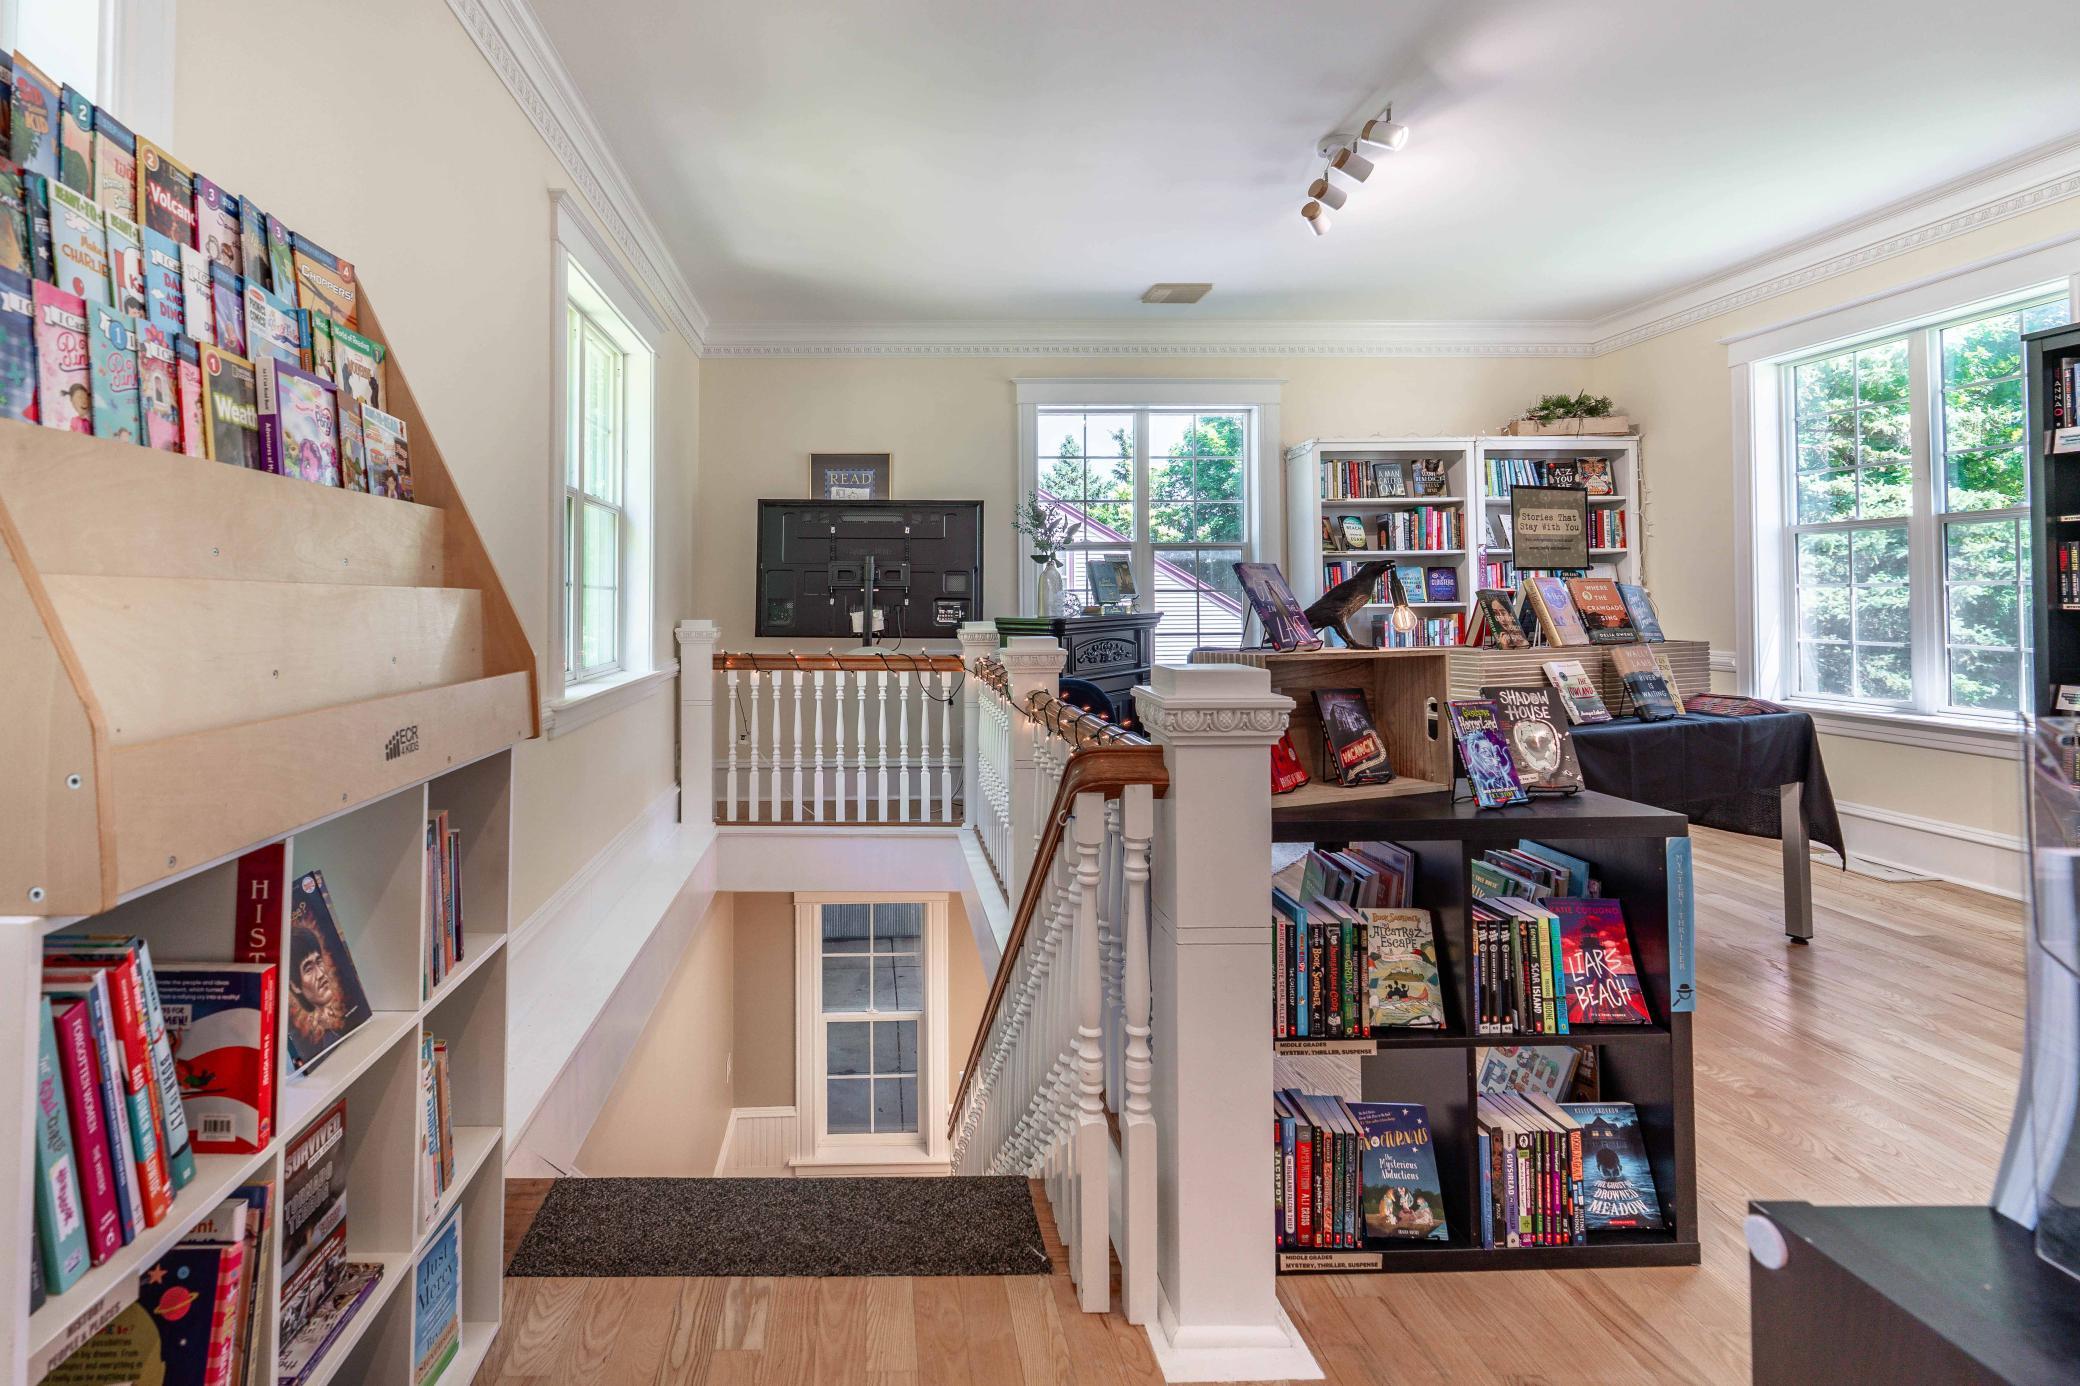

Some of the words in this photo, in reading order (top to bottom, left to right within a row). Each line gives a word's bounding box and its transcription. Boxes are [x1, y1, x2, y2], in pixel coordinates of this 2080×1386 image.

[829, 472, 873, 485] READ
[1554, 475, 1573, 483] YOU
[1519, 522, 1538, 532] Stay
[1541, 523, 1561, 531] With
[1565, 523, 1579, 531] You
[1521, 512, 1553, 521] Stories
[1557, 513, 1577, 522] That
[1276, 615, 1319, 643] LAKE
[1626, 648, 1648, 657] WALLY
[1639, 673, 1657, 681] RIVER
[1498, 689, 1551, 706] SHADOW
[1504, 705, 1552, 722] HOUSE
[400, 725, 419, 744] ECR
[1342, 737, 1375, 764] VACANCY
[1312, 947, 1322, 969] BOOK
[1568, 947, 1622, 982] LIAR'S
[1344, 959, 1353, 994] GRIMM
[1531, 962, 1540, 984] SCAR
[1312, 970, 1322, 1009] SCAVENGER
[1532, 985, 1542, 1014] ISLAND
[1574, 975, 1632, 1011] BEACH
[1329, 990, 1338, 1012] CODE
[1545, 1002, 1553, 1021] BOONE
[72, 1018, 91, 1088] FORGOTTEN
[83, 1089, 97, 1134] WOMEN
[131, 1066, 144, 1091] BAD
[160, 1055, 180, 1093] BORN
[170, 1108, 185, 1132] FLY
[136, 1093, 152, 1133] WOMEN
[142, 1134, 161, 1198] WORLDWIDE
[1379, 1158, 1418, 1172] Mysterious
[1381, 1169, 1420, 1181] Abductions
[1274, 1151, 1282, 1203] JACKPOT
[1301, 1193, 1309, 1205] ALI
[1593, 1189, 1639, 1201] DROWNED
[1300, 1207, 1310, 1226] CROSS
[1588, 1199, 1650, 1216] MEADOW
